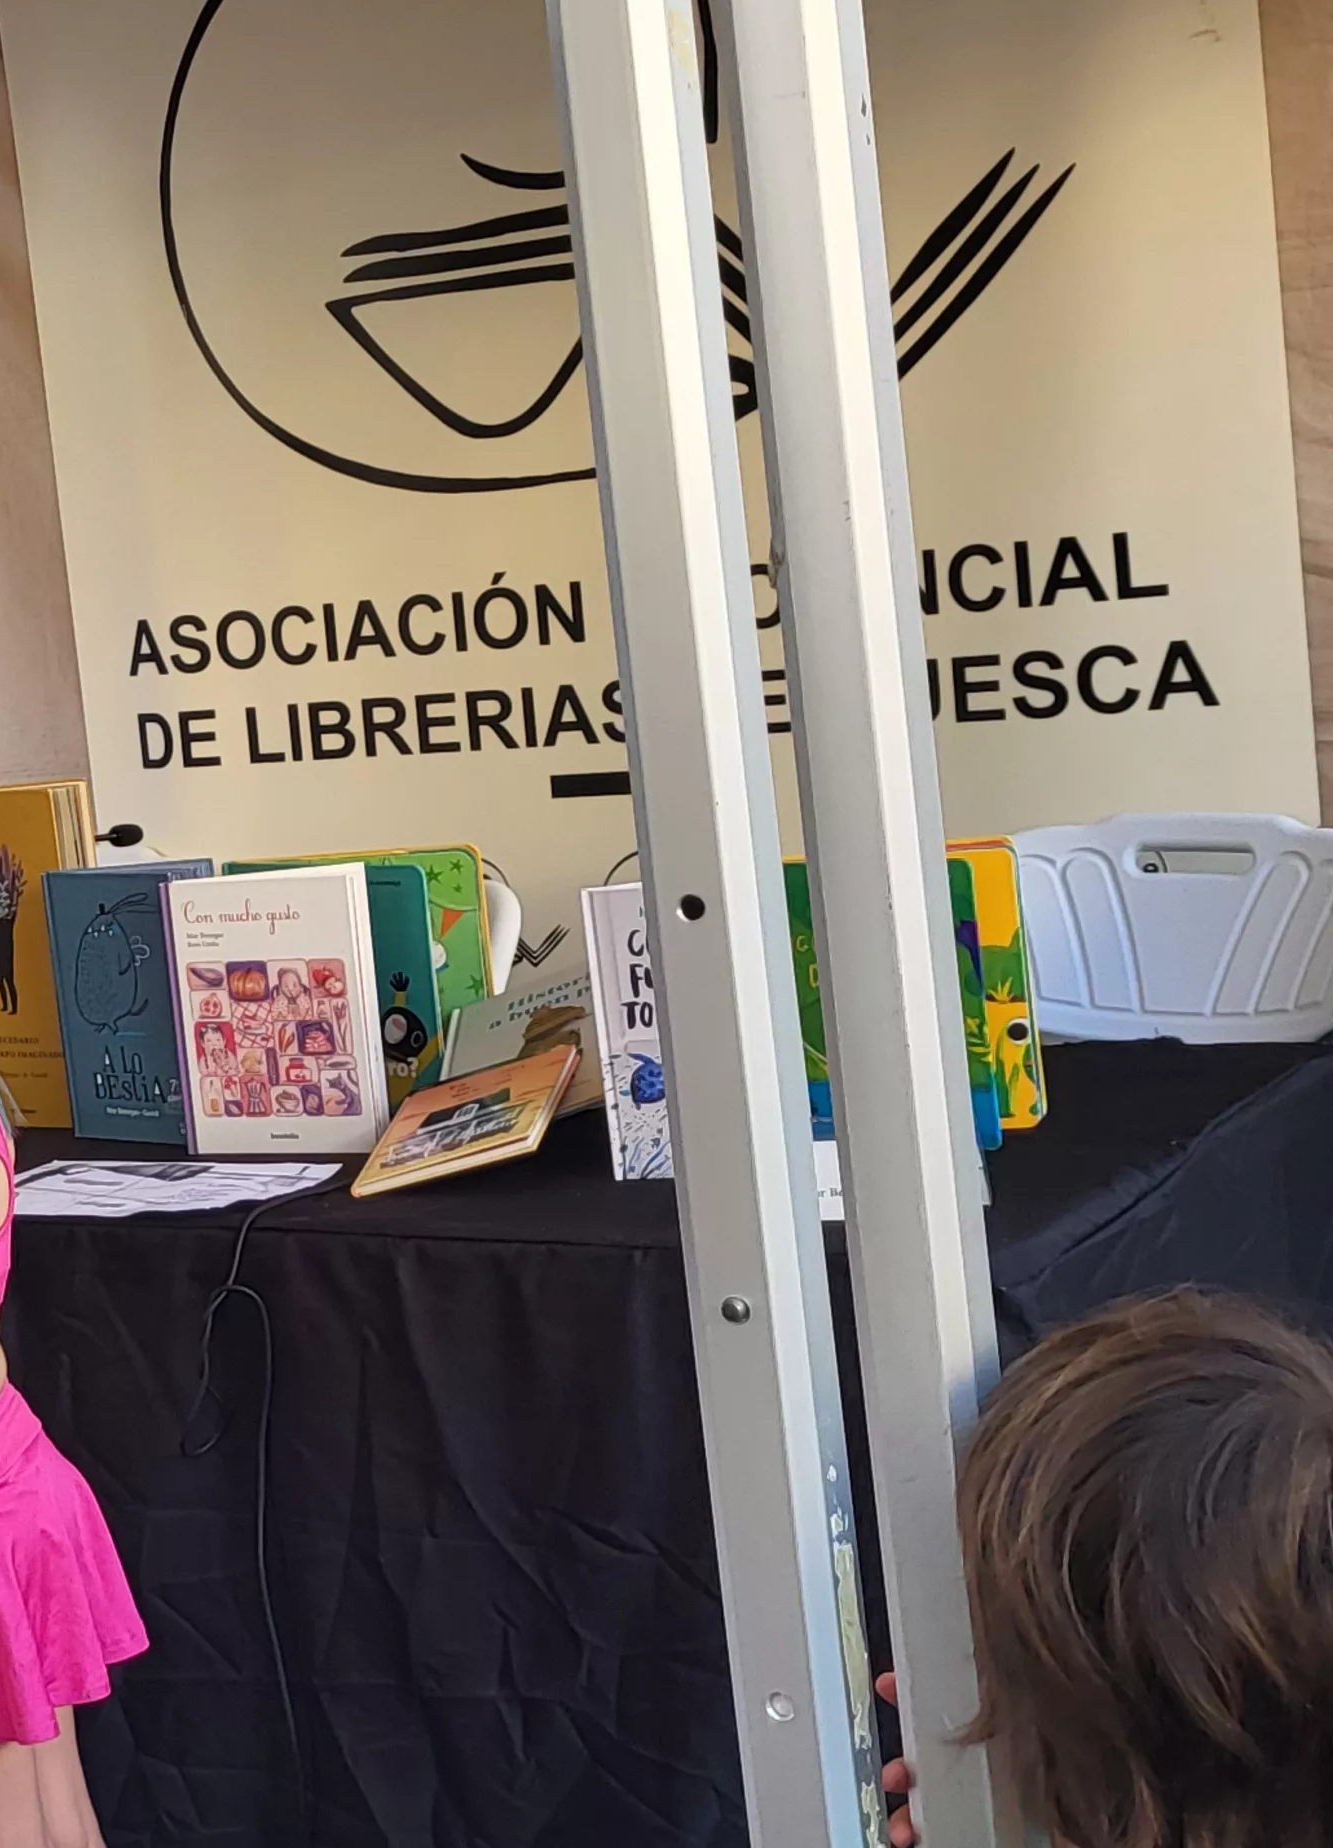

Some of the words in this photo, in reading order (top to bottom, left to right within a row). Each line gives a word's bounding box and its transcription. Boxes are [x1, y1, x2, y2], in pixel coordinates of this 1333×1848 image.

[129, 571, 586, 677] ASOCIACIÓN
[137, 708, 222, 769] DE
[245, 678, 627, 765] LIBRERIAS
[181, 900, 213, 924] Con
[219, 897, 262, 922] mucho
[266, 904, 300, 935] gusto
[104, 1045, 116, 1073] A
[387, 1056, 419, 1078] ro?
